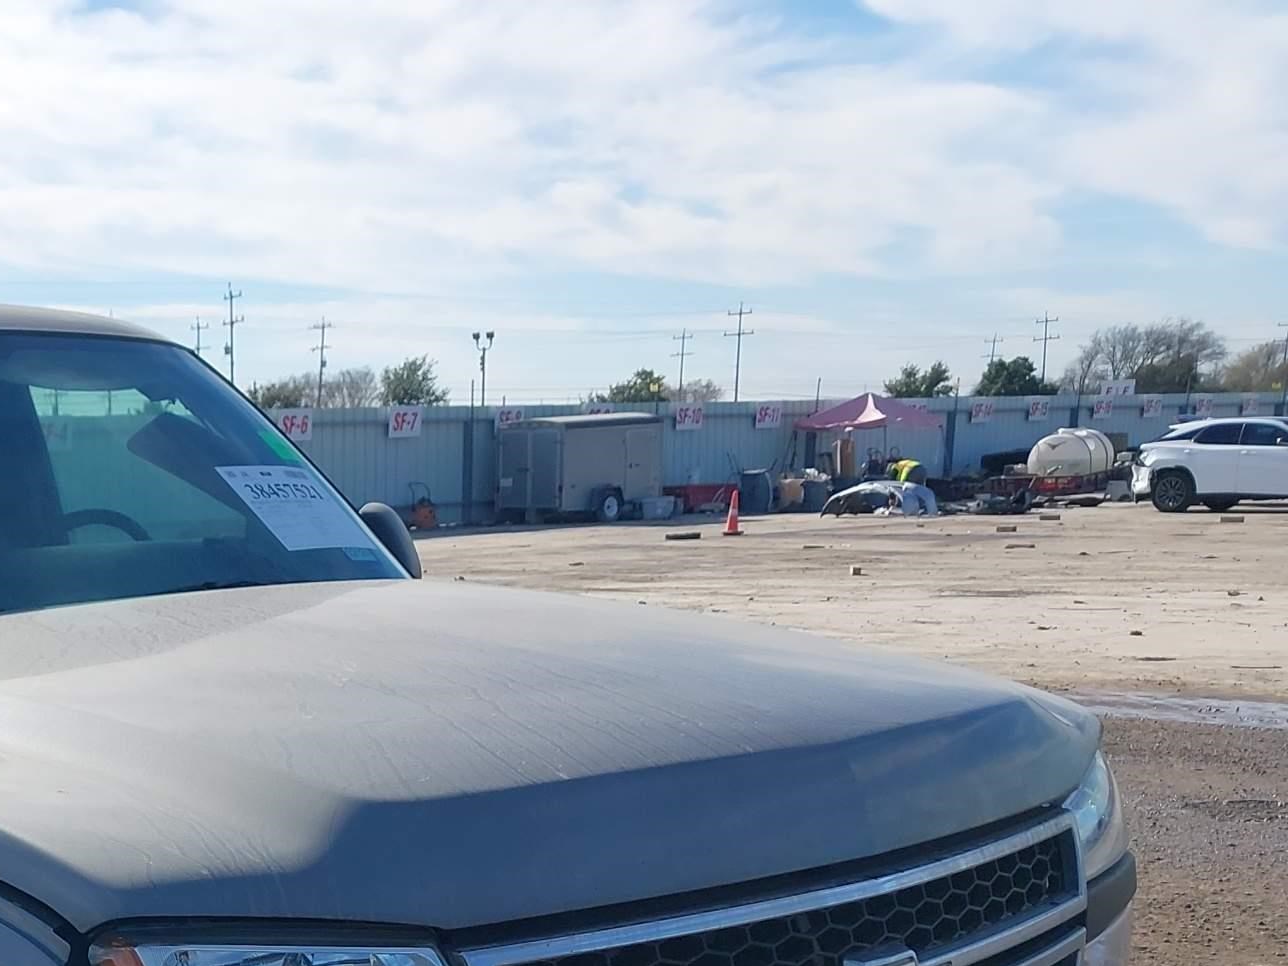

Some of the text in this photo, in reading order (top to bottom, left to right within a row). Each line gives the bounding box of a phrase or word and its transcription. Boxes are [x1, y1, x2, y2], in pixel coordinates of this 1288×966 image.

[392, 411, 419, 432] SF-7
[677, 407, 703, 425] SF-10
[757, 405, 781, 424] SF-11
[282, 414, 309, 435] SF-6
[244, 482, 324, 501] 38457521
